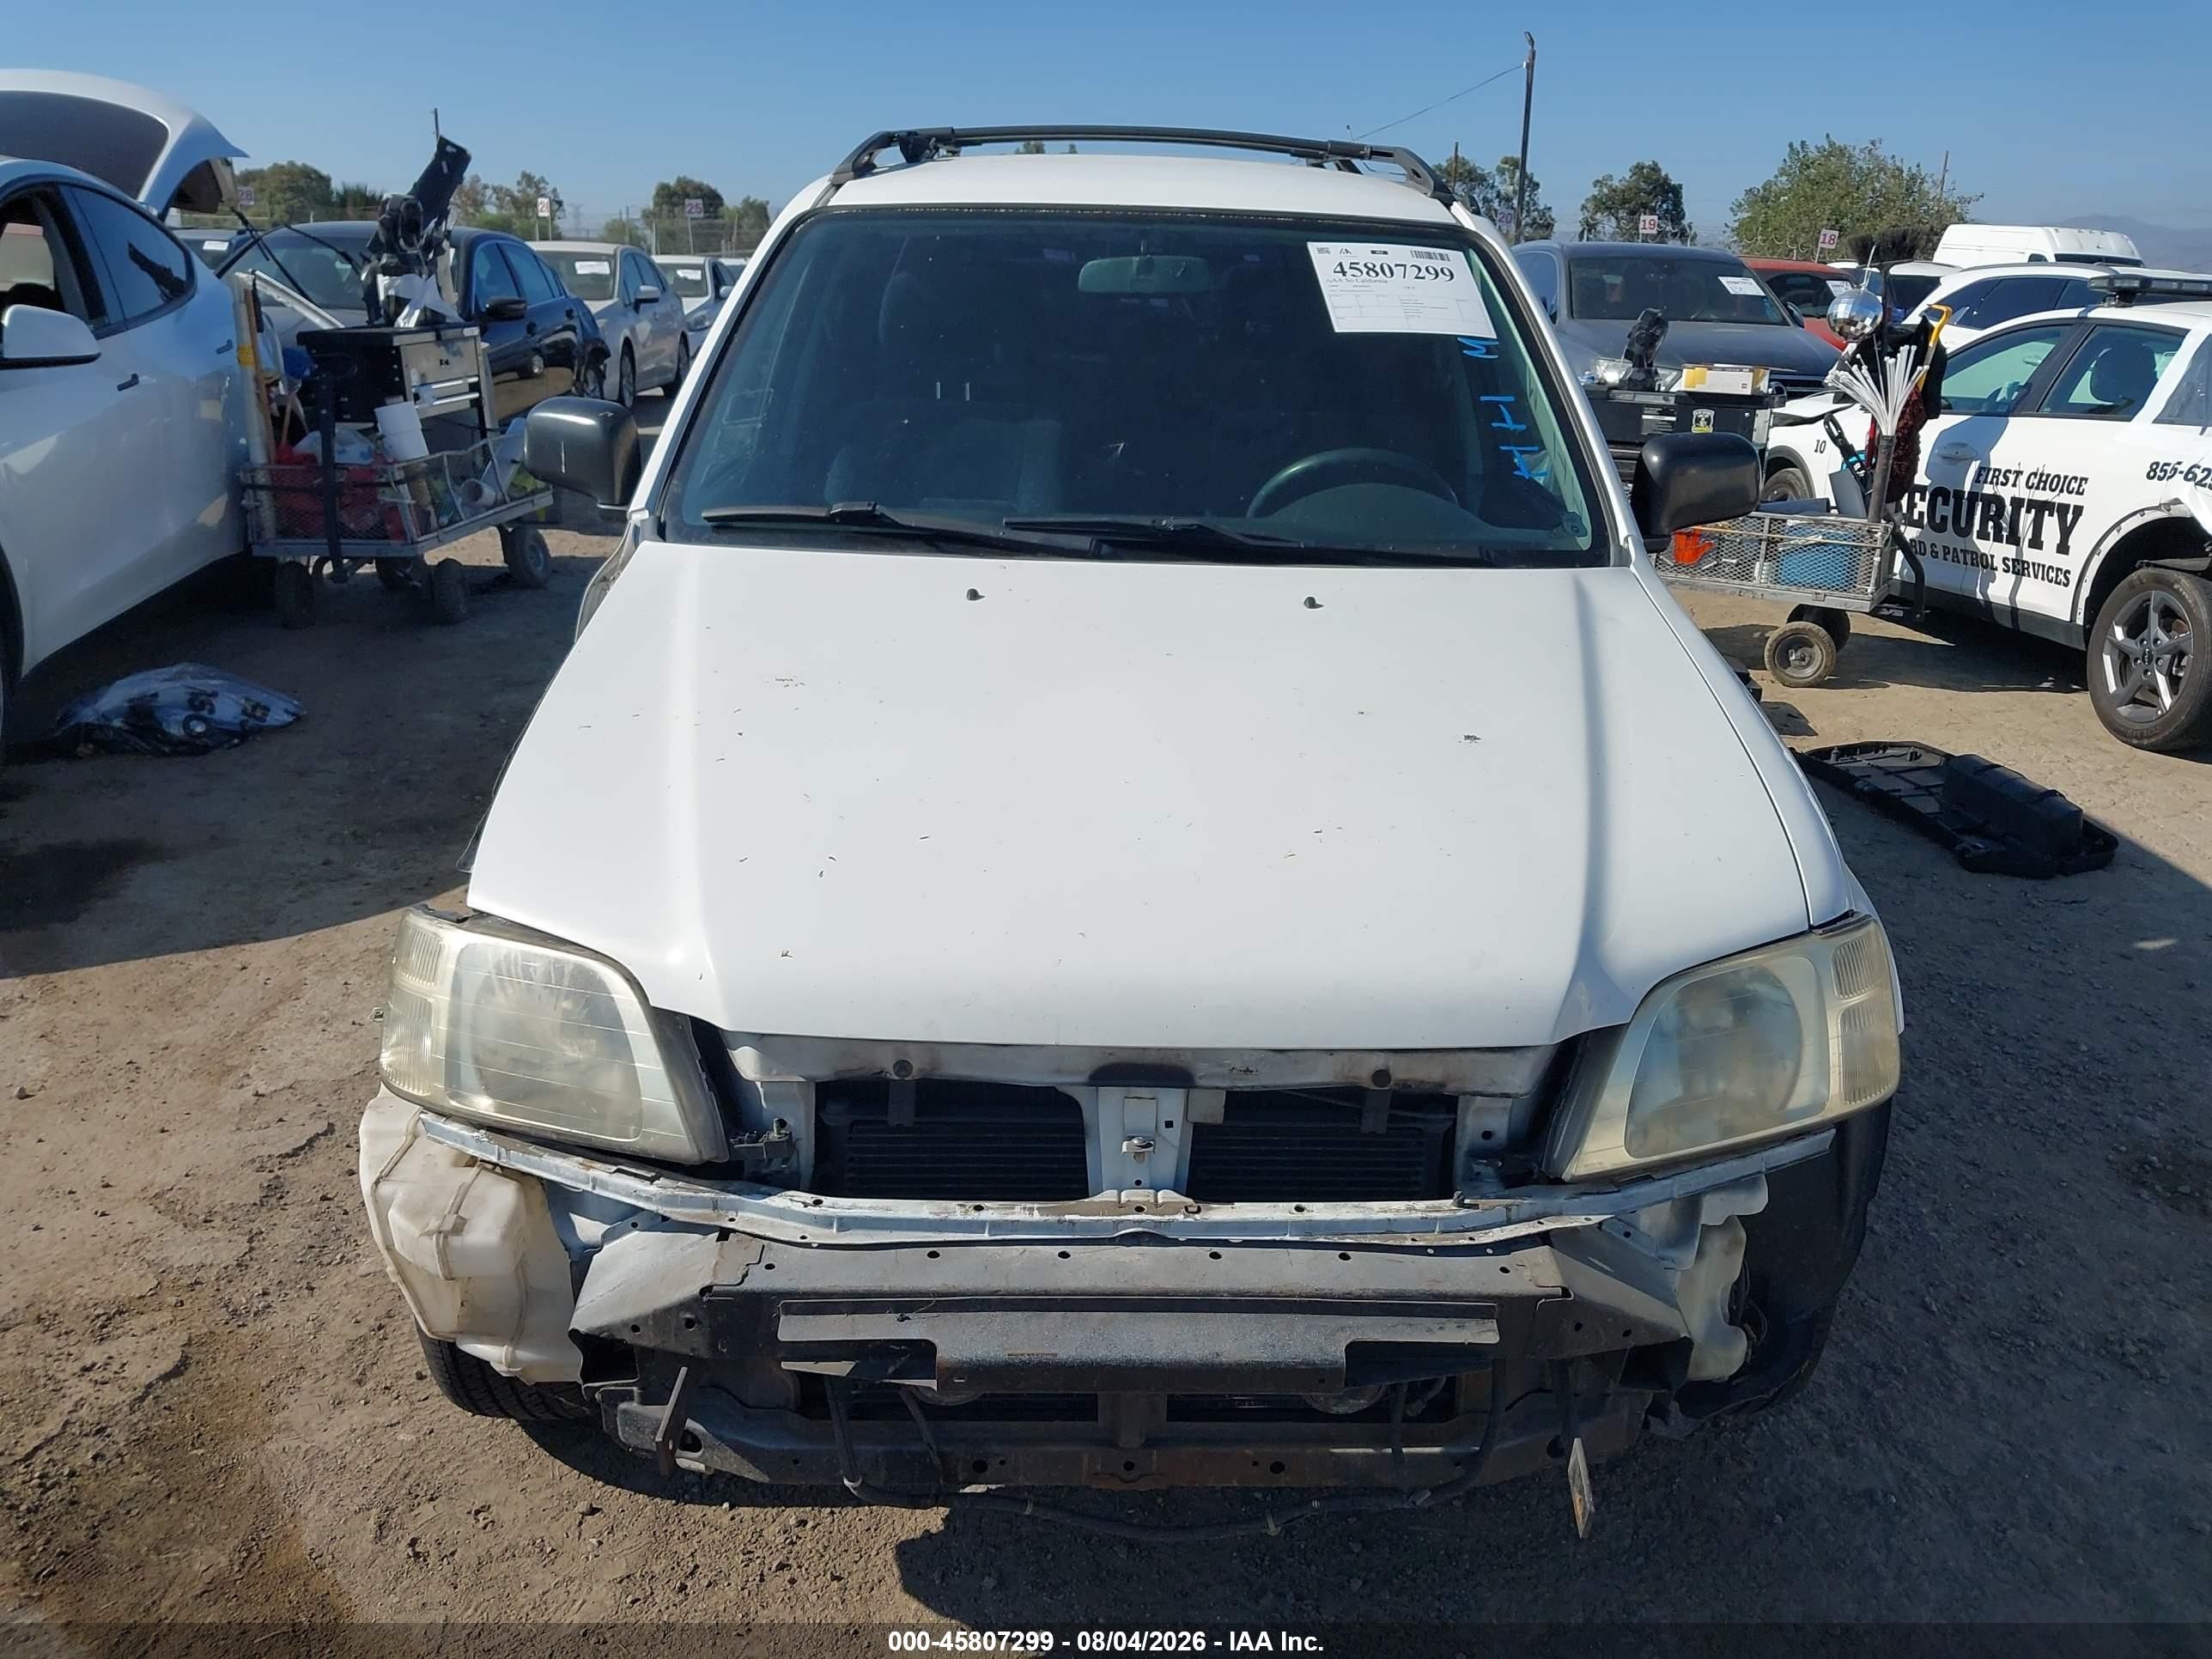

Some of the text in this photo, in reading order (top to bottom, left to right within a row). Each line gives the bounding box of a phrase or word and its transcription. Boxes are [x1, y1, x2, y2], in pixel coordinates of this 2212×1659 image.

[1498, 211, 1512, 224] 20
[1641, 218, 1656, 230] 19
[1820, 233, 1837, 246] 18
[1333, 261, 1455, 283] 45807299
[1814, 439, 1827, 454] 10
[1975, 466, 2089, 496] FIRST CHOICE
[1897, 483, 2085, 556] ECURITY
[1929, 542, 1940, 560] &
[1942, 544, 1998, 572] PATROL
[2002, 556, 2072, 587] SERVICES
